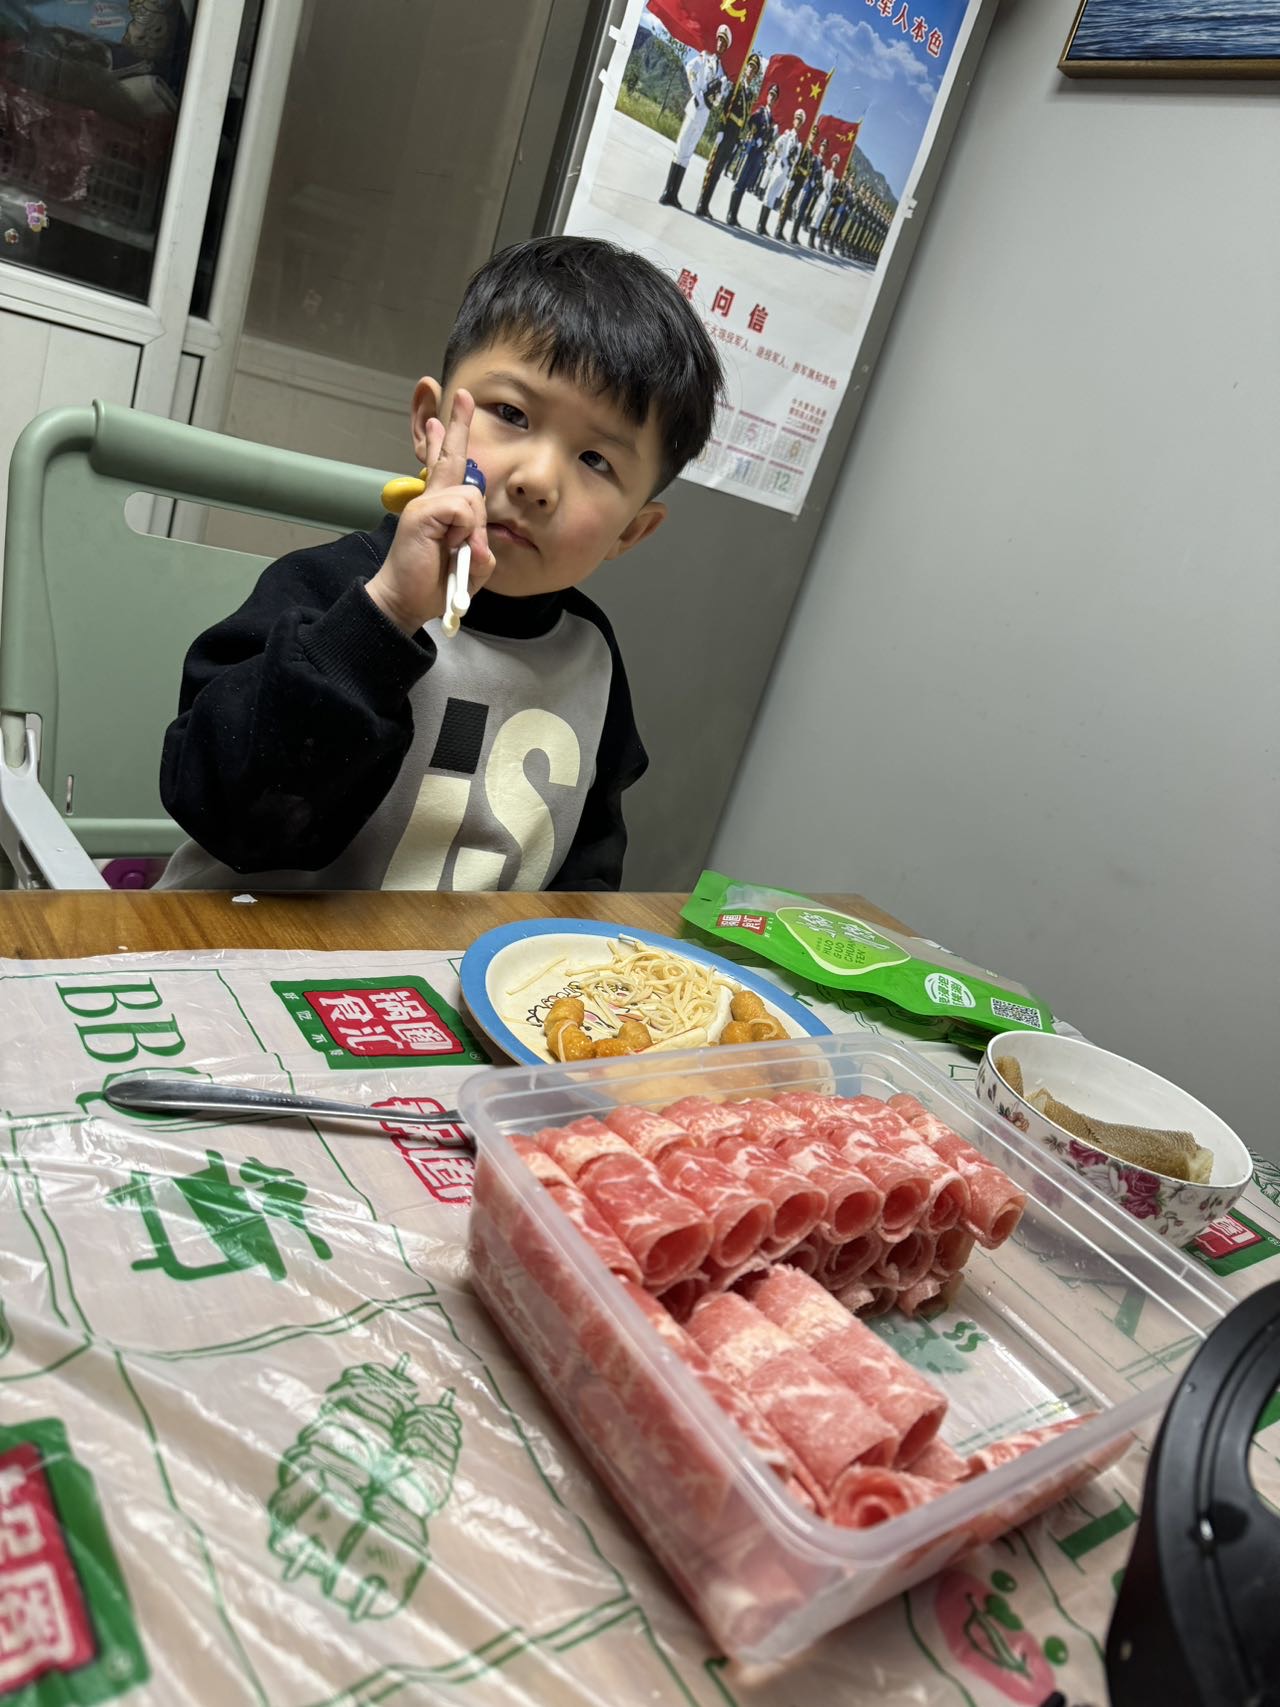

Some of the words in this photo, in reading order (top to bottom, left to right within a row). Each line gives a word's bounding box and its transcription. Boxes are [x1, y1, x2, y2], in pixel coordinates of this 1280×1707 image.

[866, 0, 943, 57] 军人本色
[677, 268, 769, 334] 慰问信
[369, 989, 453, 1050] 锅圈
